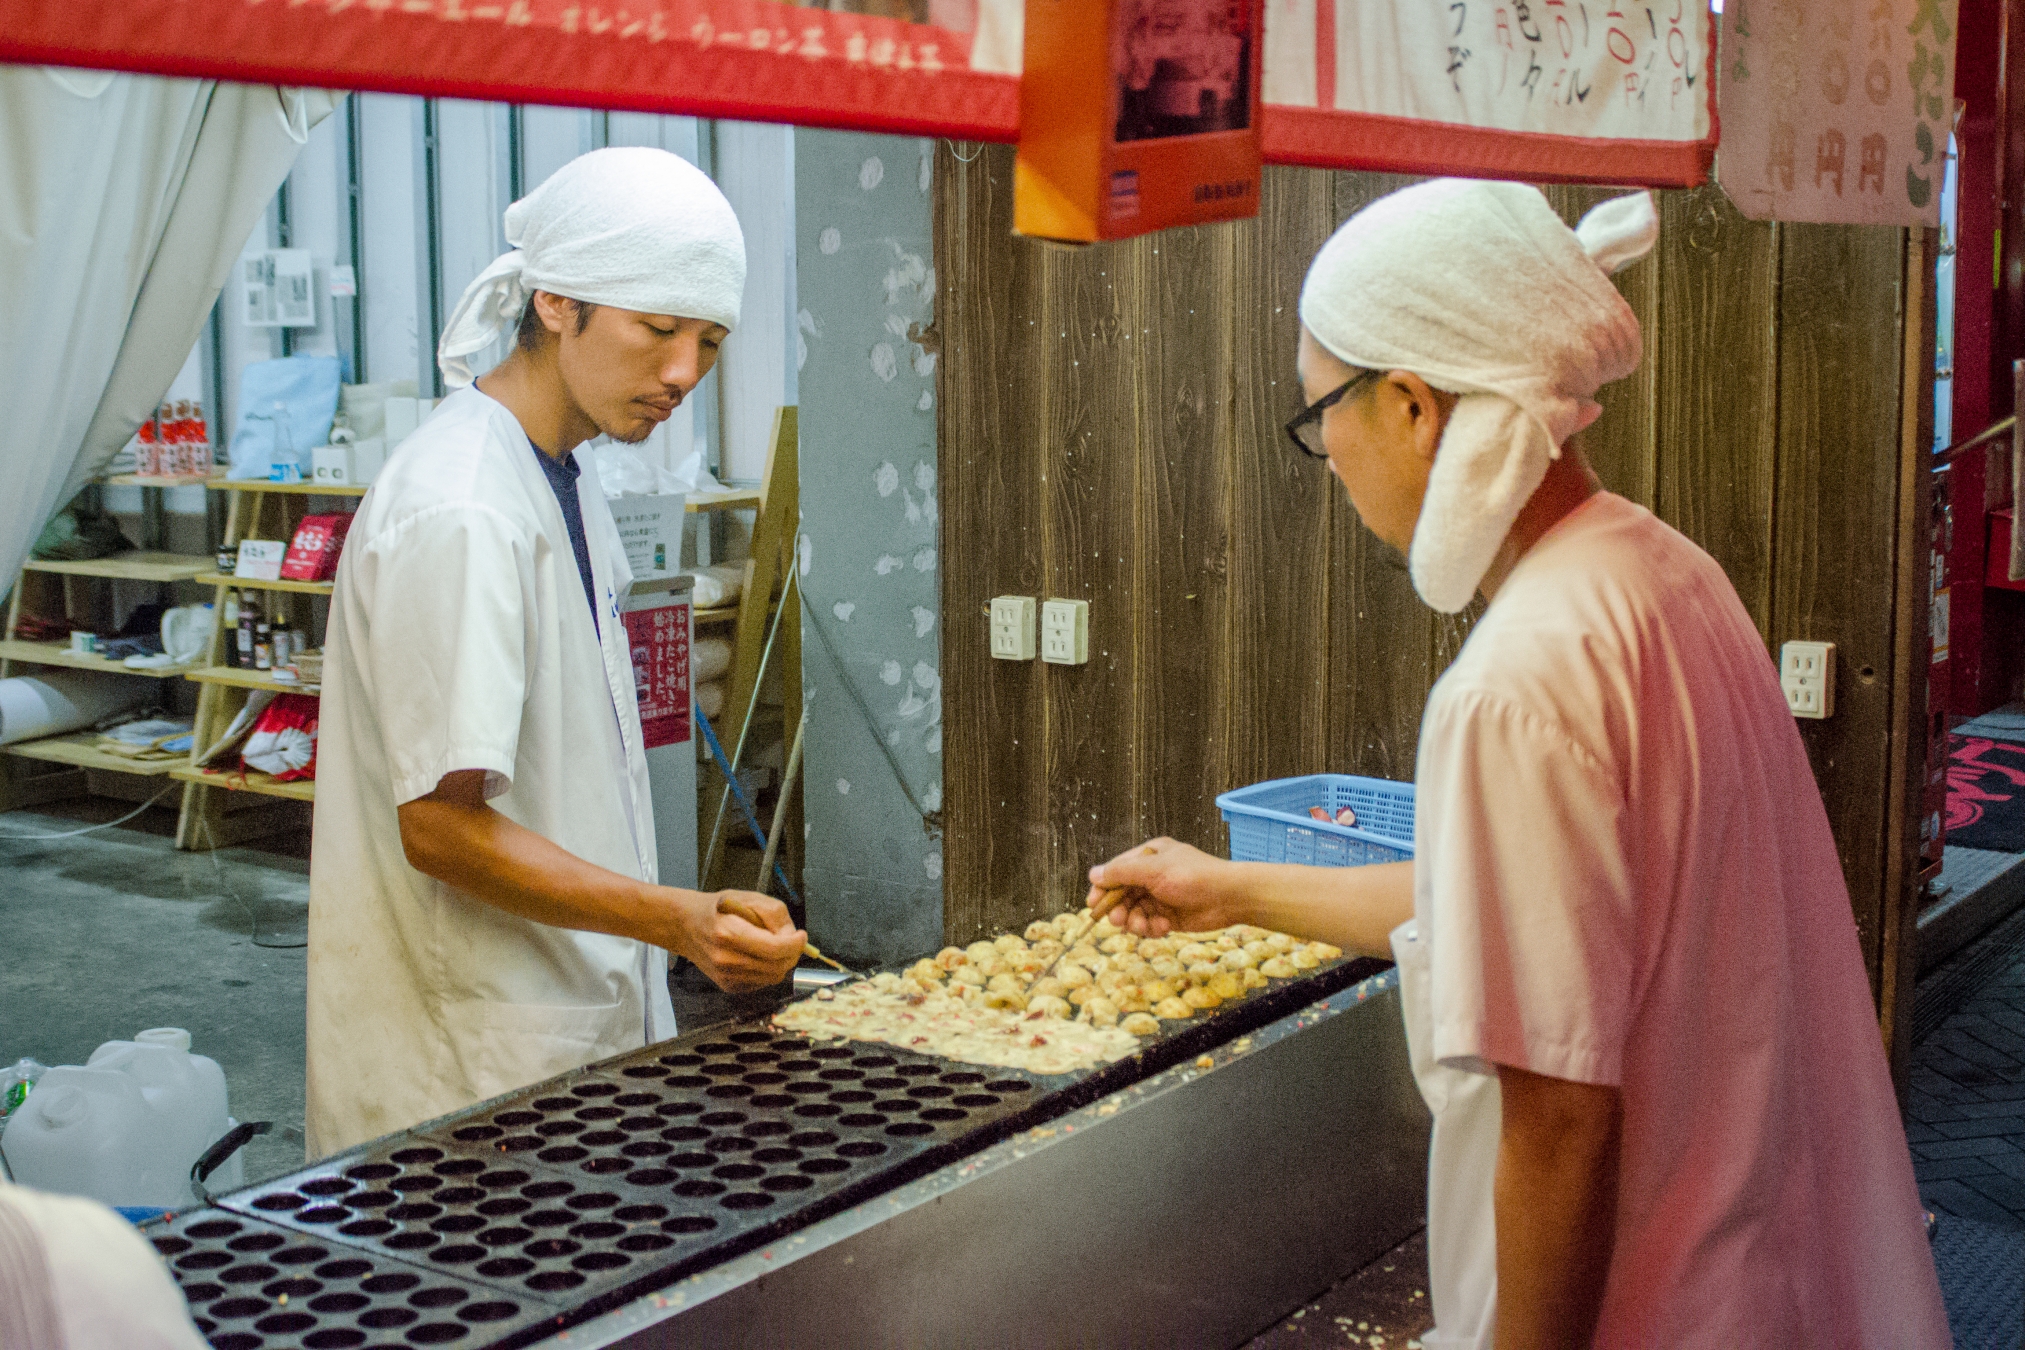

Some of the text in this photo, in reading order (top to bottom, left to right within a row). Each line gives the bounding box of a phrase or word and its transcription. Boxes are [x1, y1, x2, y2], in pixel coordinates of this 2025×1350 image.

[676, 609, 687, 692] おみやげ用
